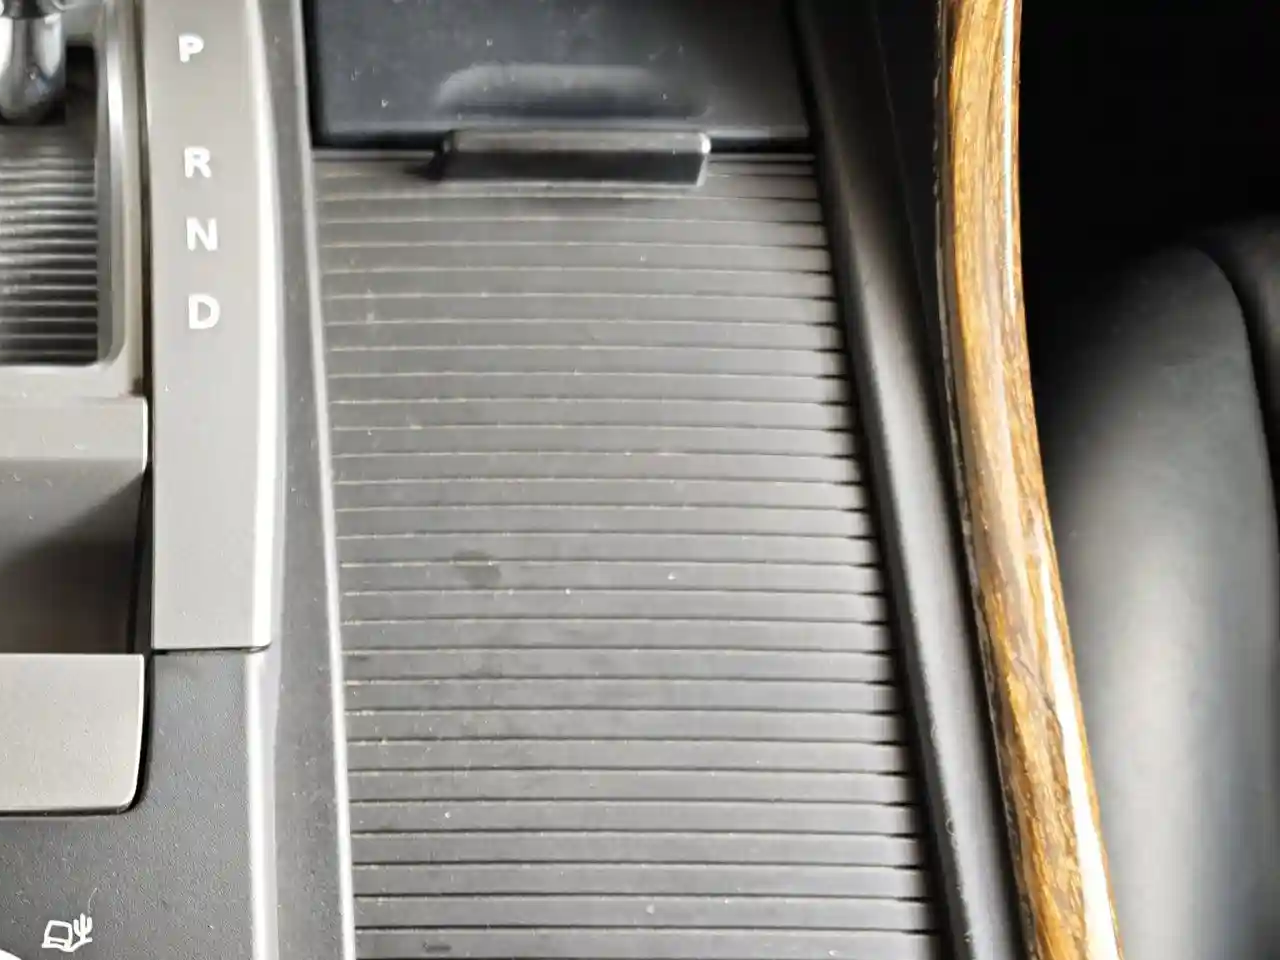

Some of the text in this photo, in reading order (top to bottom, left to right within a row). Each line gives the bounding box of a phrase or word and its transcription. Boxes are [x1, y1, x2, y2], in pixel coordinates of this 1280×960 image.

[178, 34, 205, 63] P
[184, 146, 212, 179] R
[186, 217, 219, 252] N
[188, 293, 221, 330] D
